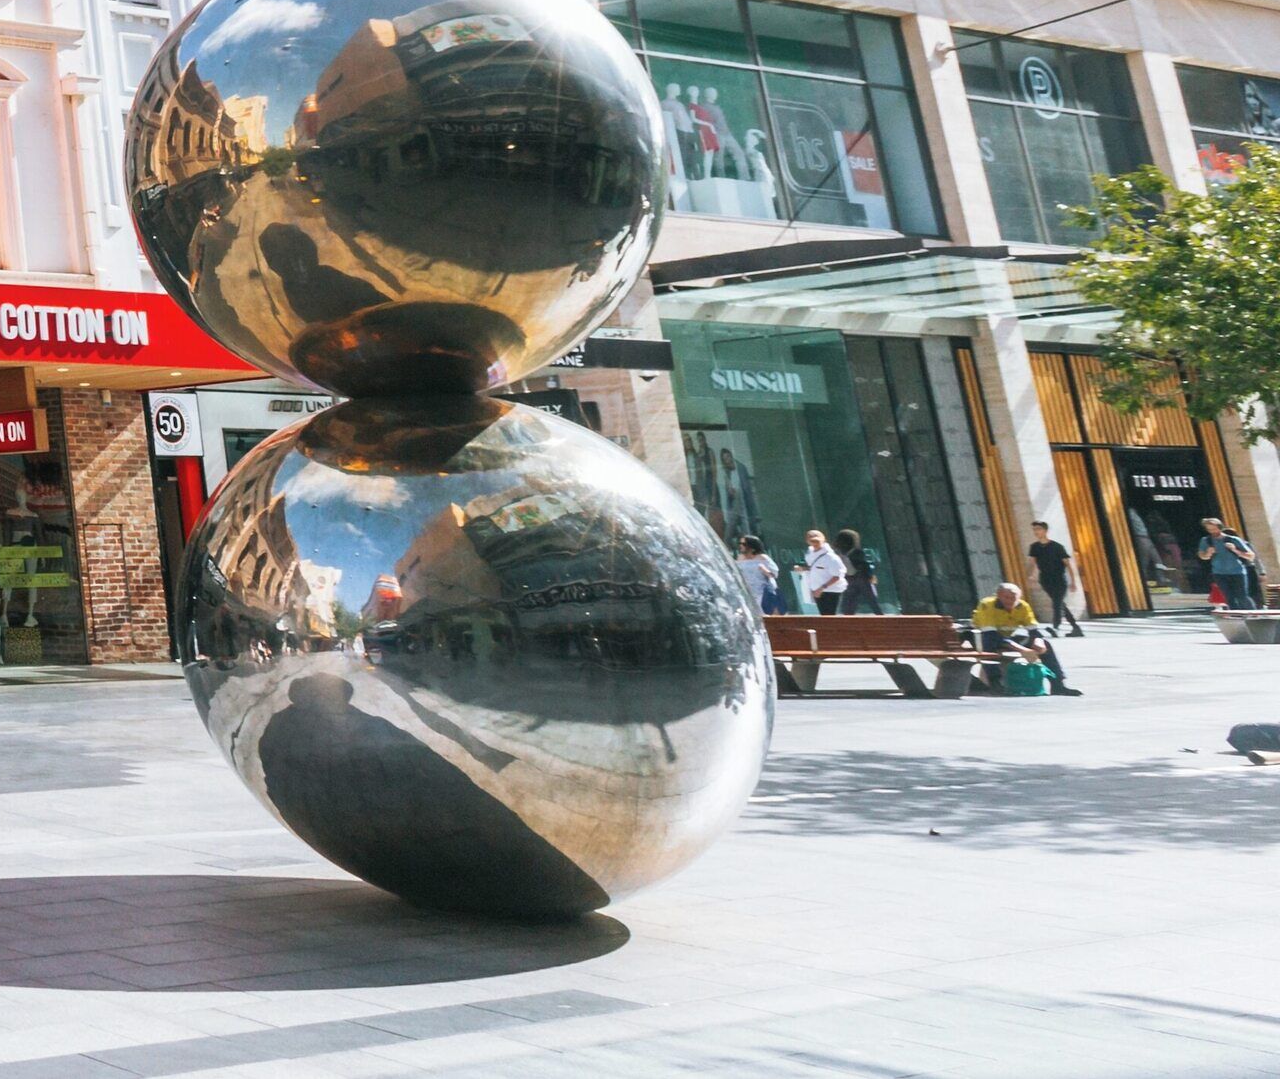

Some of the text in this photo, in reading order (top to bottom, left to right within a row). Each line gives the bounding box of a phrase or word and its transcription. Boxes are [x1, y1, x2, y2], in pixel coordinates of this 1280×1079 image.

[848, 156, 877, 173] SALE
[0, 302, 150, 346] COTTON ON
[551, 355, 585, 368] ANE
[710, 369, 804, 394] sussan
[7, 421, 27, 442] ON
[158, 411, 182, 436] 50
[1132, 475, 1198, 488] TED BAKER
